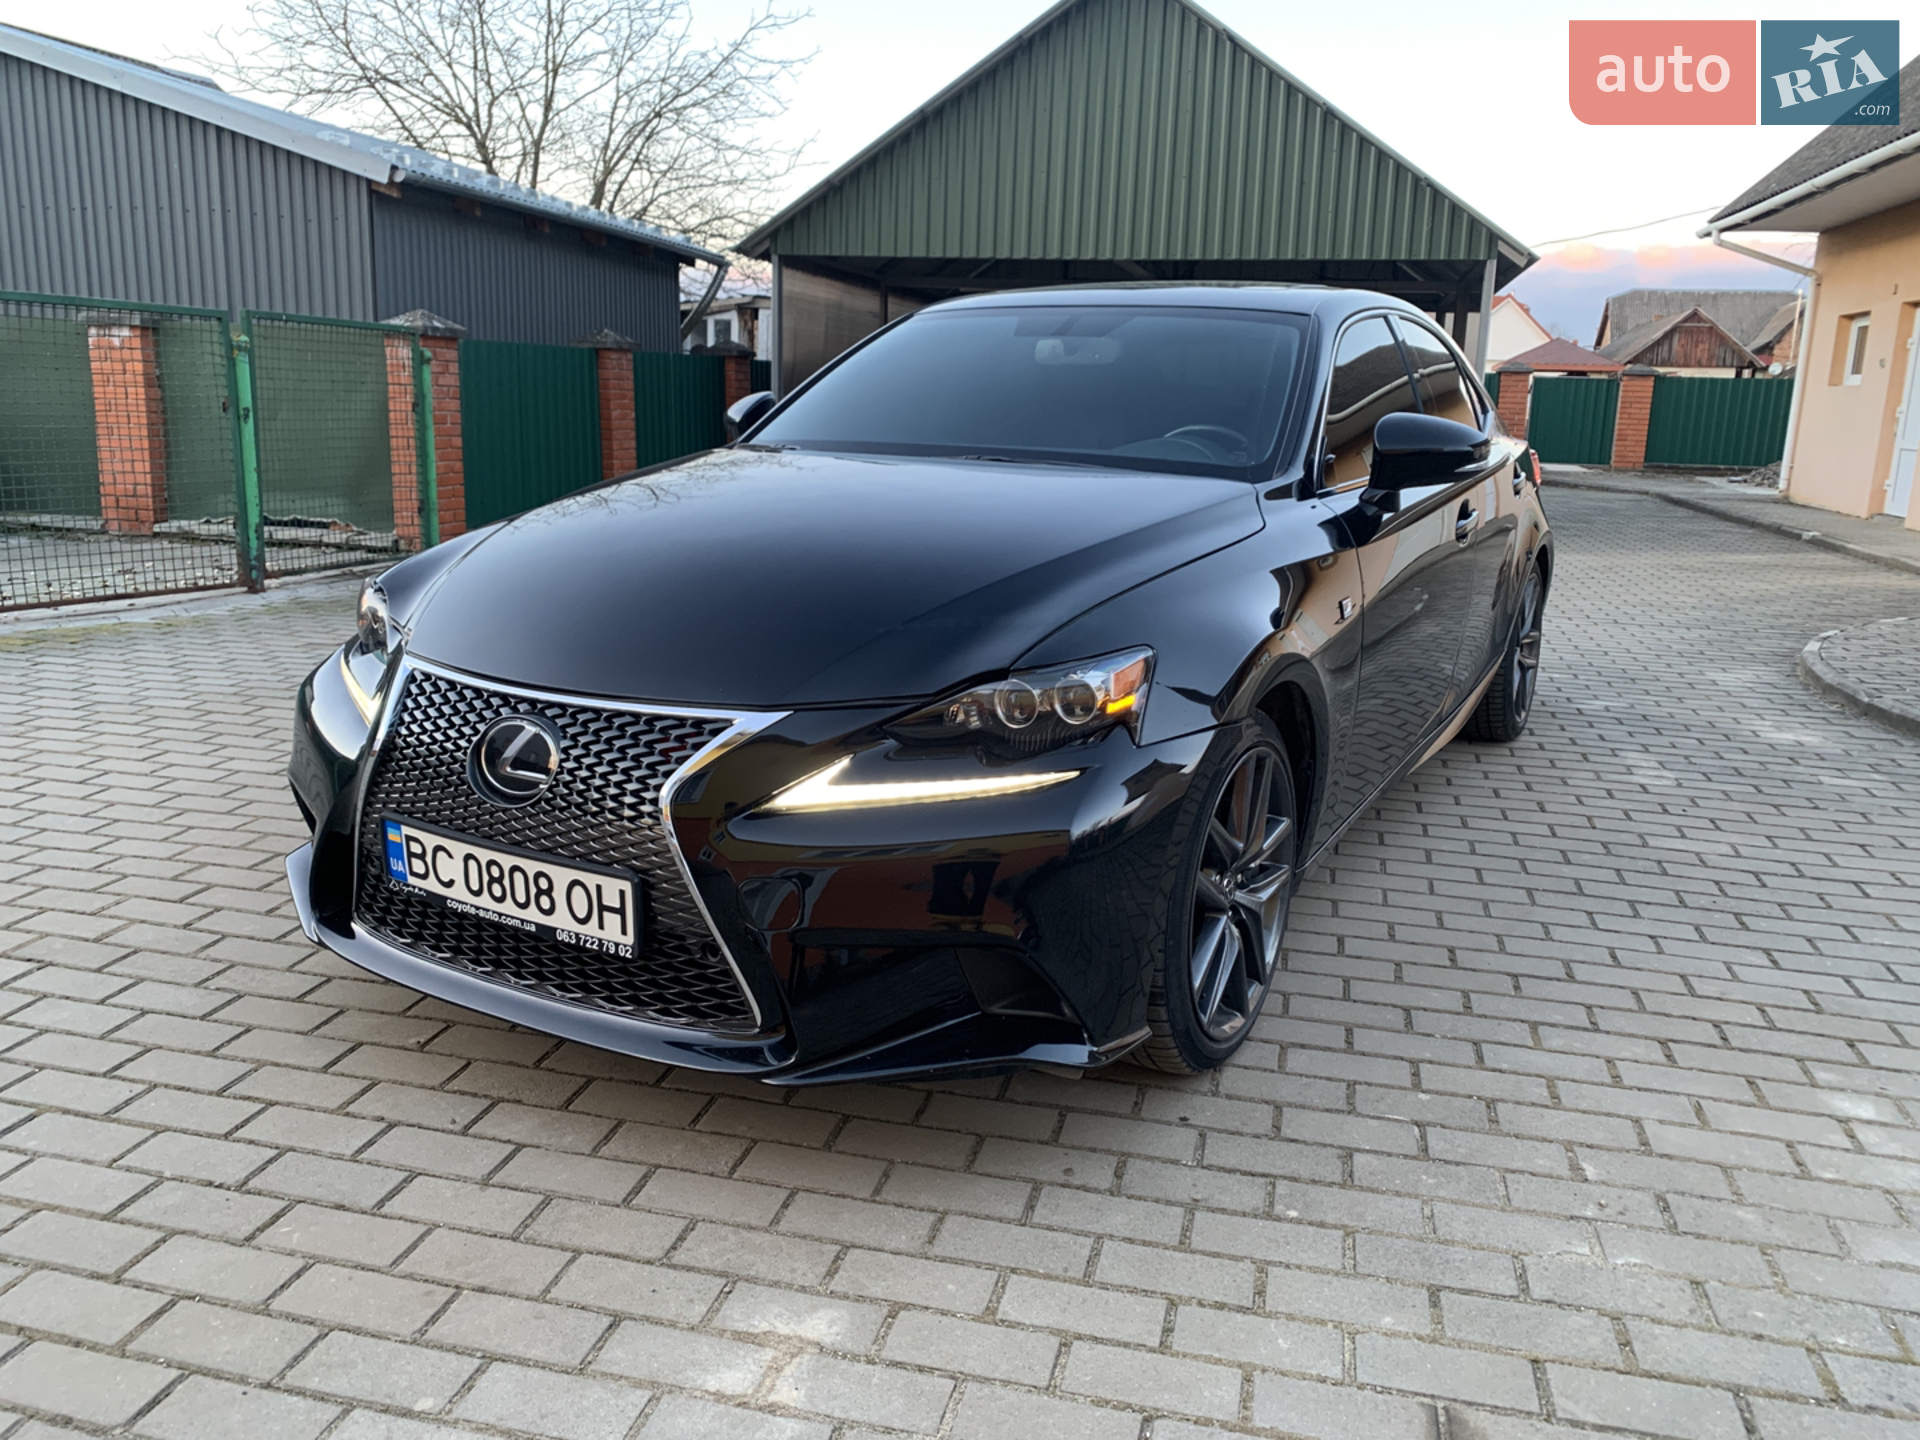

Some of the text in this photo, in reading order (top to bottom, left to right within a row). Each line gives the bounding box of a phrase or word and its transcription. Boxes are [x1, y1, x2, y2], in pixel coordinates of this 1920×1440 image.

[390, 857, 405, 874] UA
[403, 833, 628, 937] BC 0808 OH
[446, 899, 537, 933] coyote-auto.com.ua
[555, 928, 633, 959] 063 722 79 02
